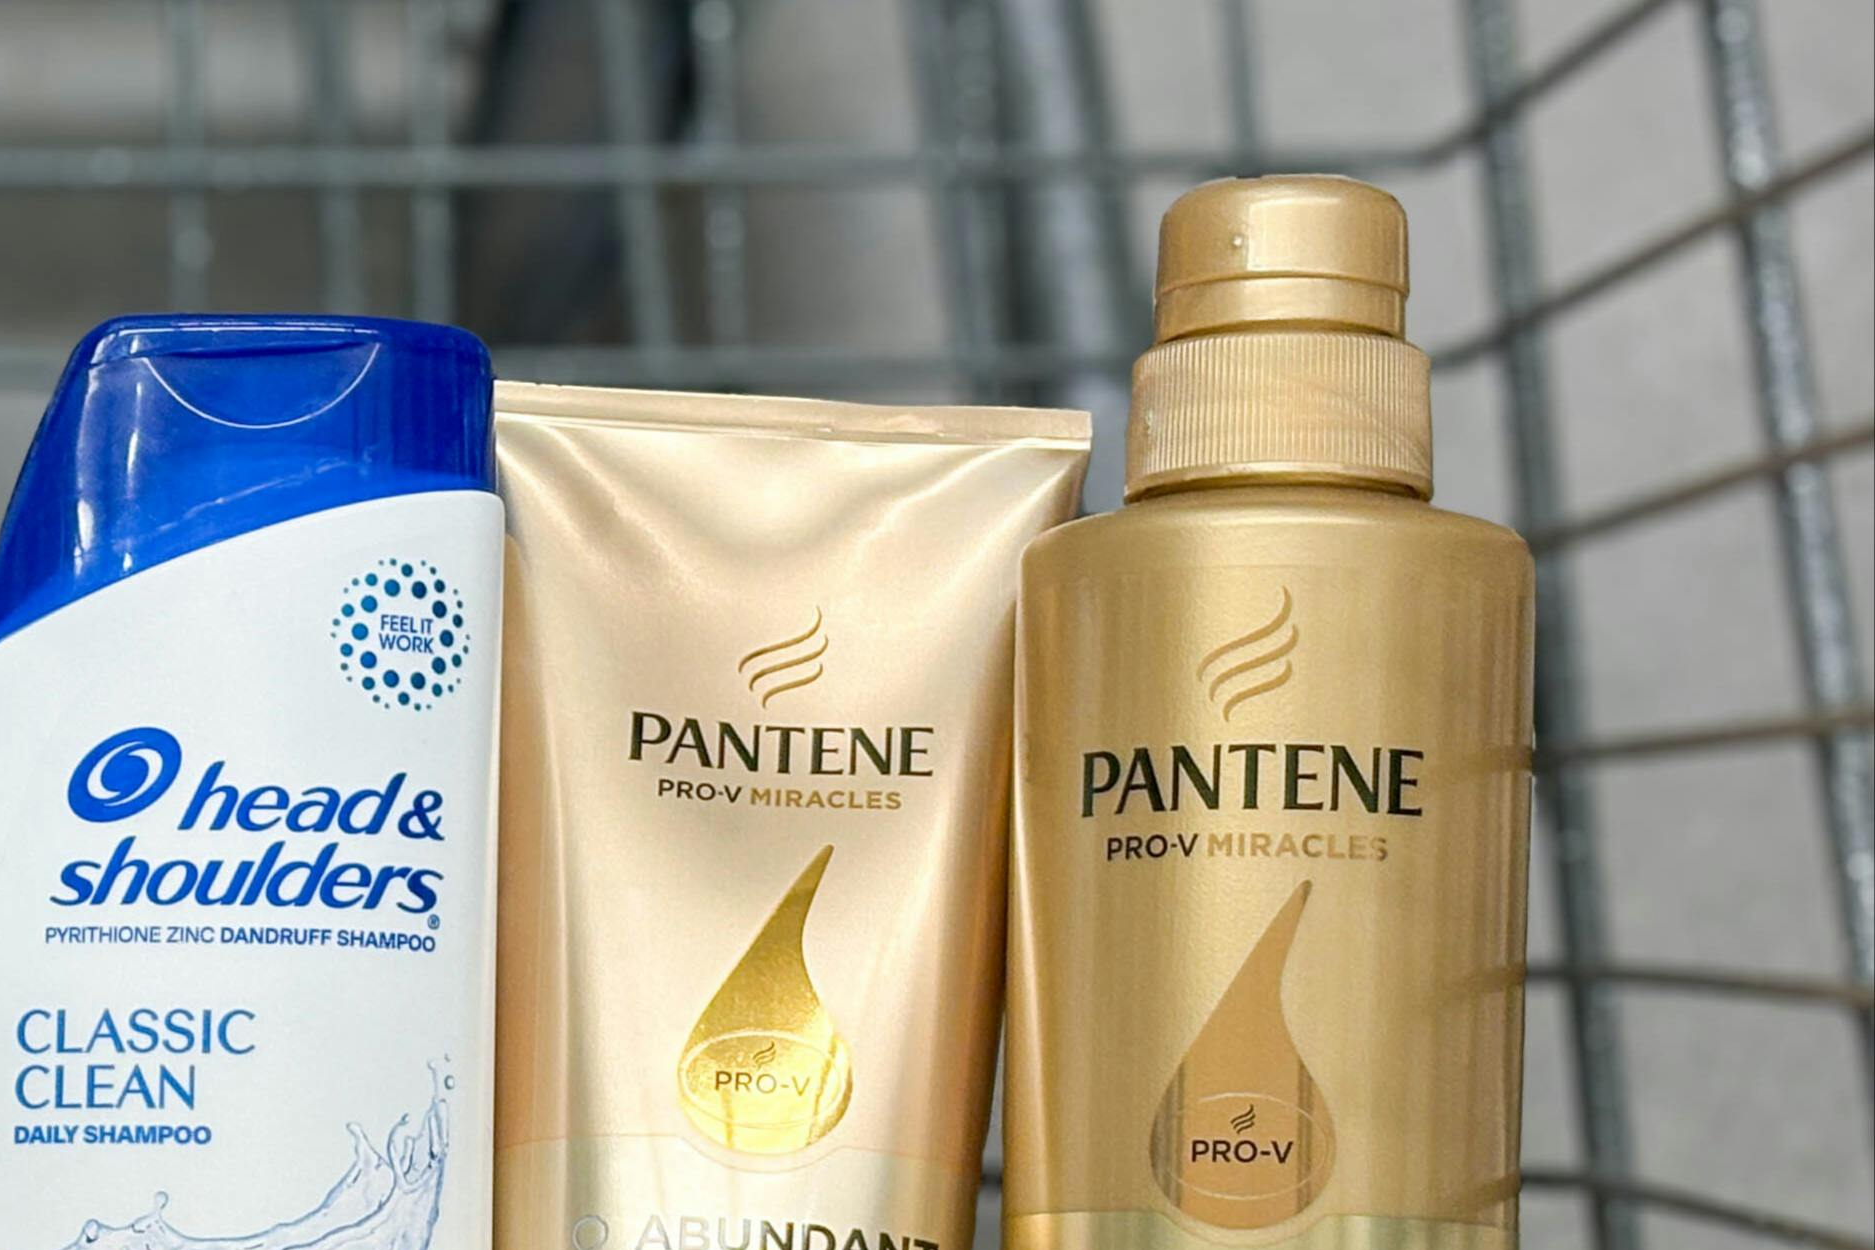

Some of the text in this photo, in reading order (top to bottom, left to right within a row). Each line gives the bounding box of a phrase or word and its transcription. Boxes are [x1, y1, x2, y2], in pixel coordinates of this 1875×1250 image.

[380, 614, 434, 634] FEEL IT
[378, 632, 434, 654] WORK
[627, 711, 935, 777] PANTENE
[1080, 743, 1425, 818] PANTENE
[657, 779, 902, 811] PRO-V MIRACLES
[1106, 832, 1389, 862] PRO-V MIRACLES
[45, 926, 436, 953] PYRITHIONE ZINC DANDRUFF SHAMPOO
[15, 1008, 256, 1054] CLASSIC
[14, 1065, 196, 1111] CLEAN
[714, 1070, 813, 1097] PRO-V
[13, 1125, 212, 1145] DAILY SHAMPOO
[1190, 1139, 1294, 1164] PRO-V
